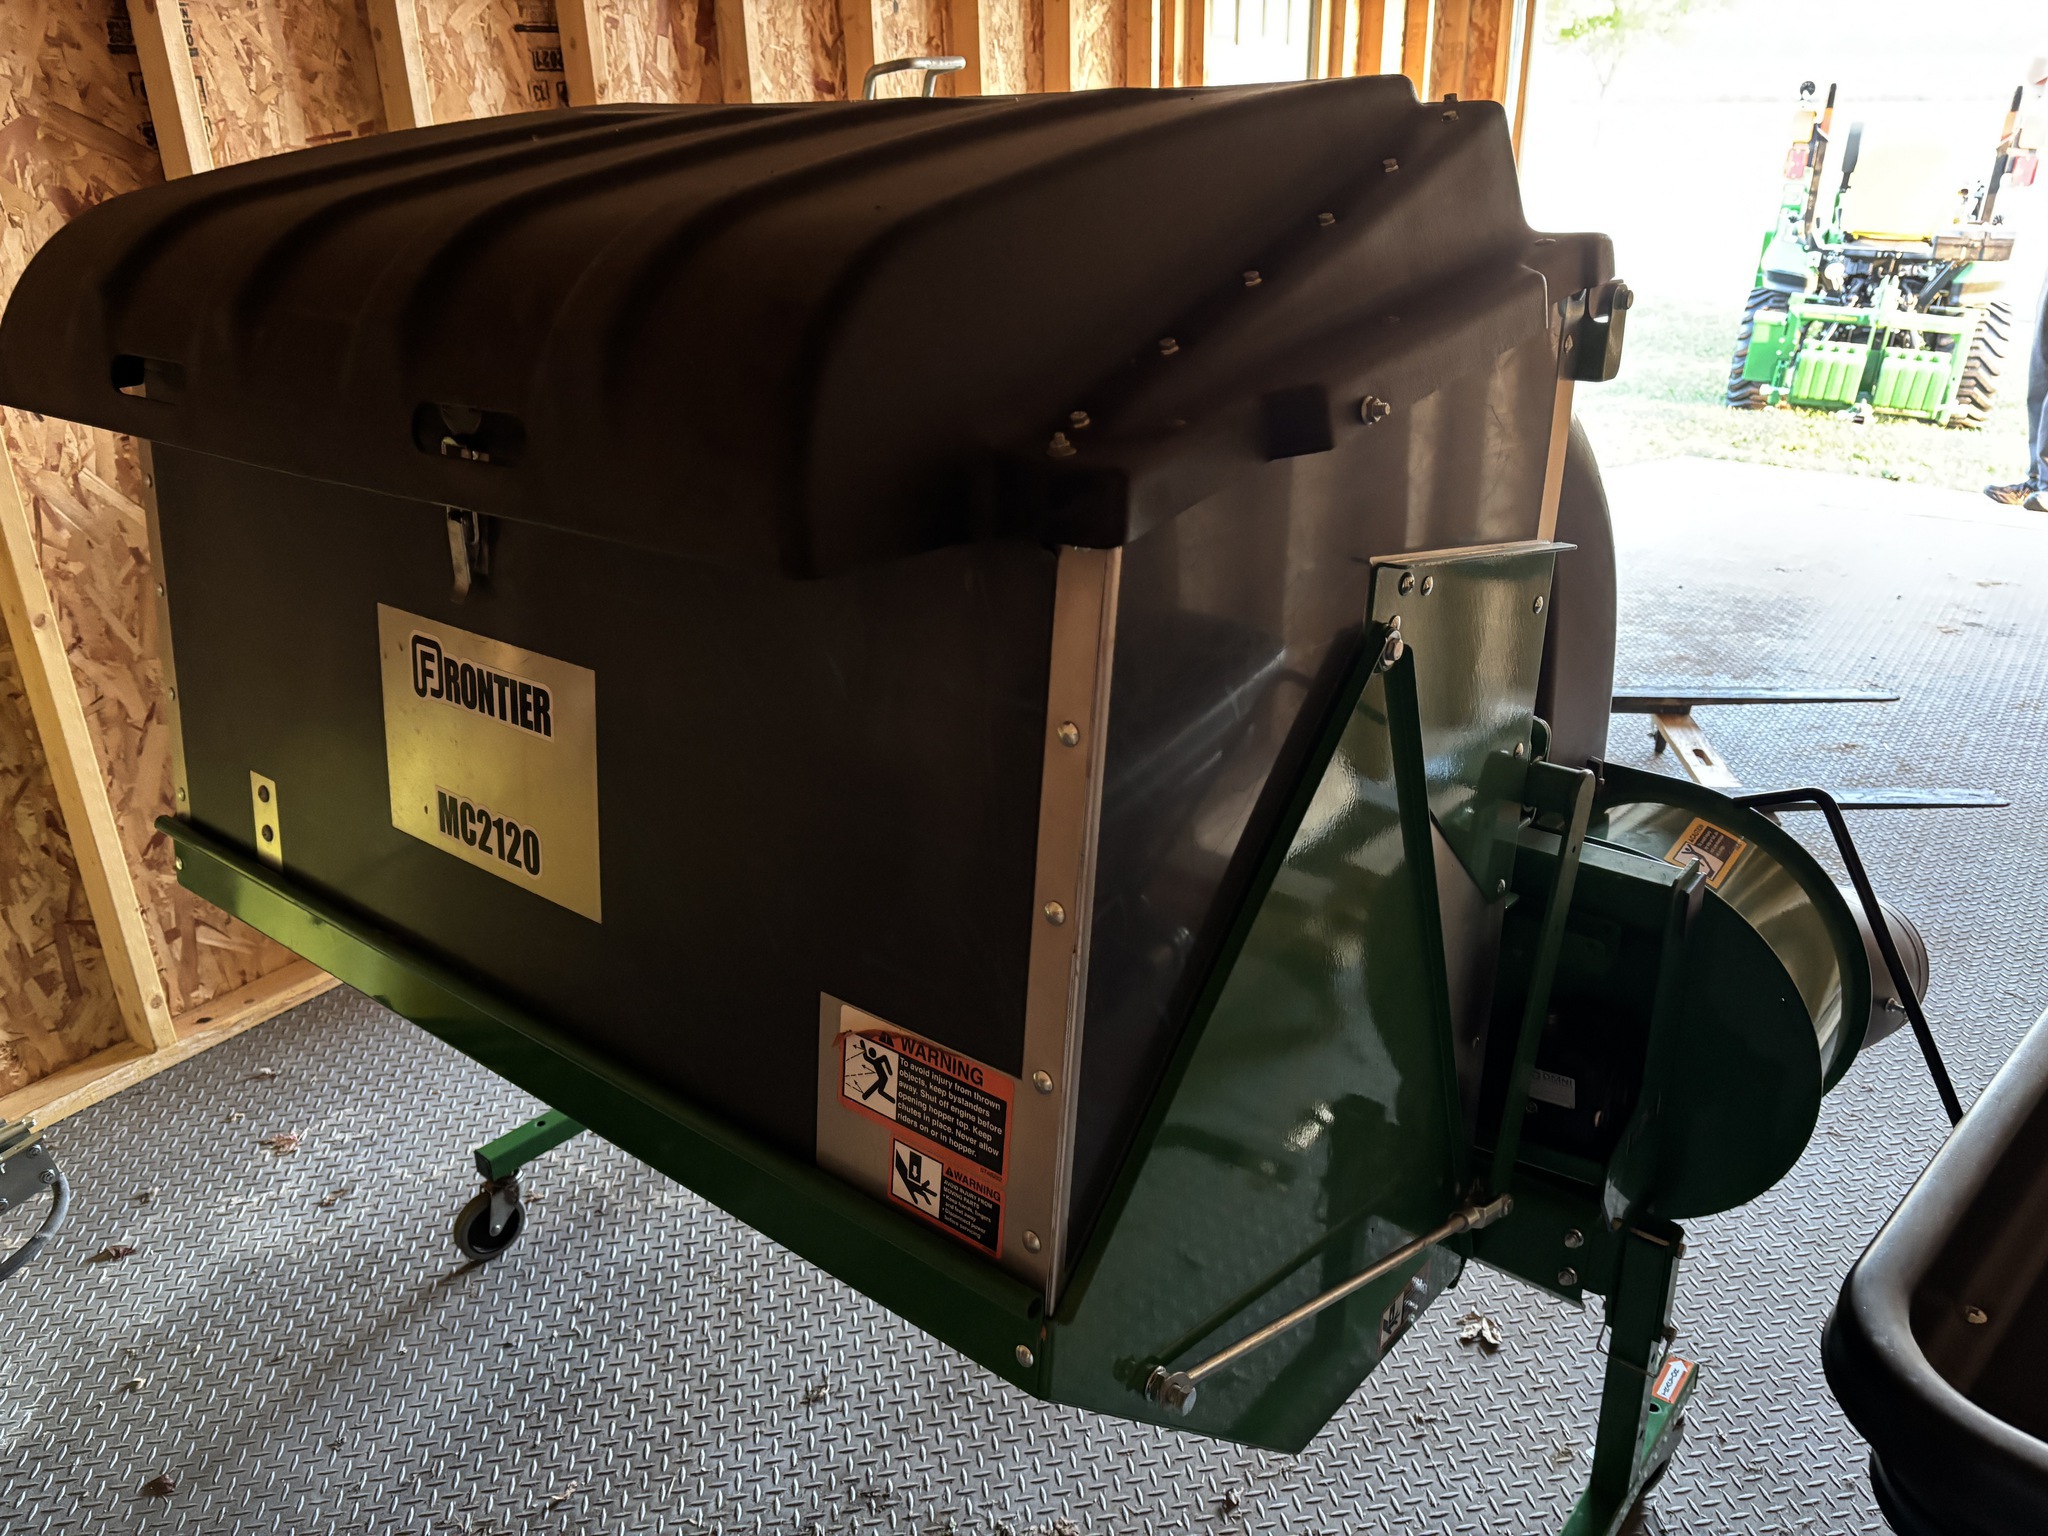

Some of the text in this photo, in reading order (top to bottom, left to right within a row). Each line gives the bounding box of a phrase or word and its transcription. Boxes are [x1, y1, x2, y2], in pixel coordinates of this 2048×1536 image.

[411, 634, 552, 738] FRONTIER
[437, 790, 541, 876] MC2120
[900, 1037, 984, 1087] WARNING
[900, 1057, 1001, 1111] To avoid injury from thrown
[898, 1080, 1003, 1135] away. Shut off engine before
[898, 1091, 993, 1143] opening hopper top. Keep
[929, 1082, 947, 1098] keep
[949, 1091, 990, 1117] bystanders
[897, 1101, 1000, 1157] chutes in place. Never allow
[897, 1112, 977, 1158] riders on or in hopper.
[954, 1170, 1001, 1202] WARNING
[963, 1197, 980, 1210] PARTS
